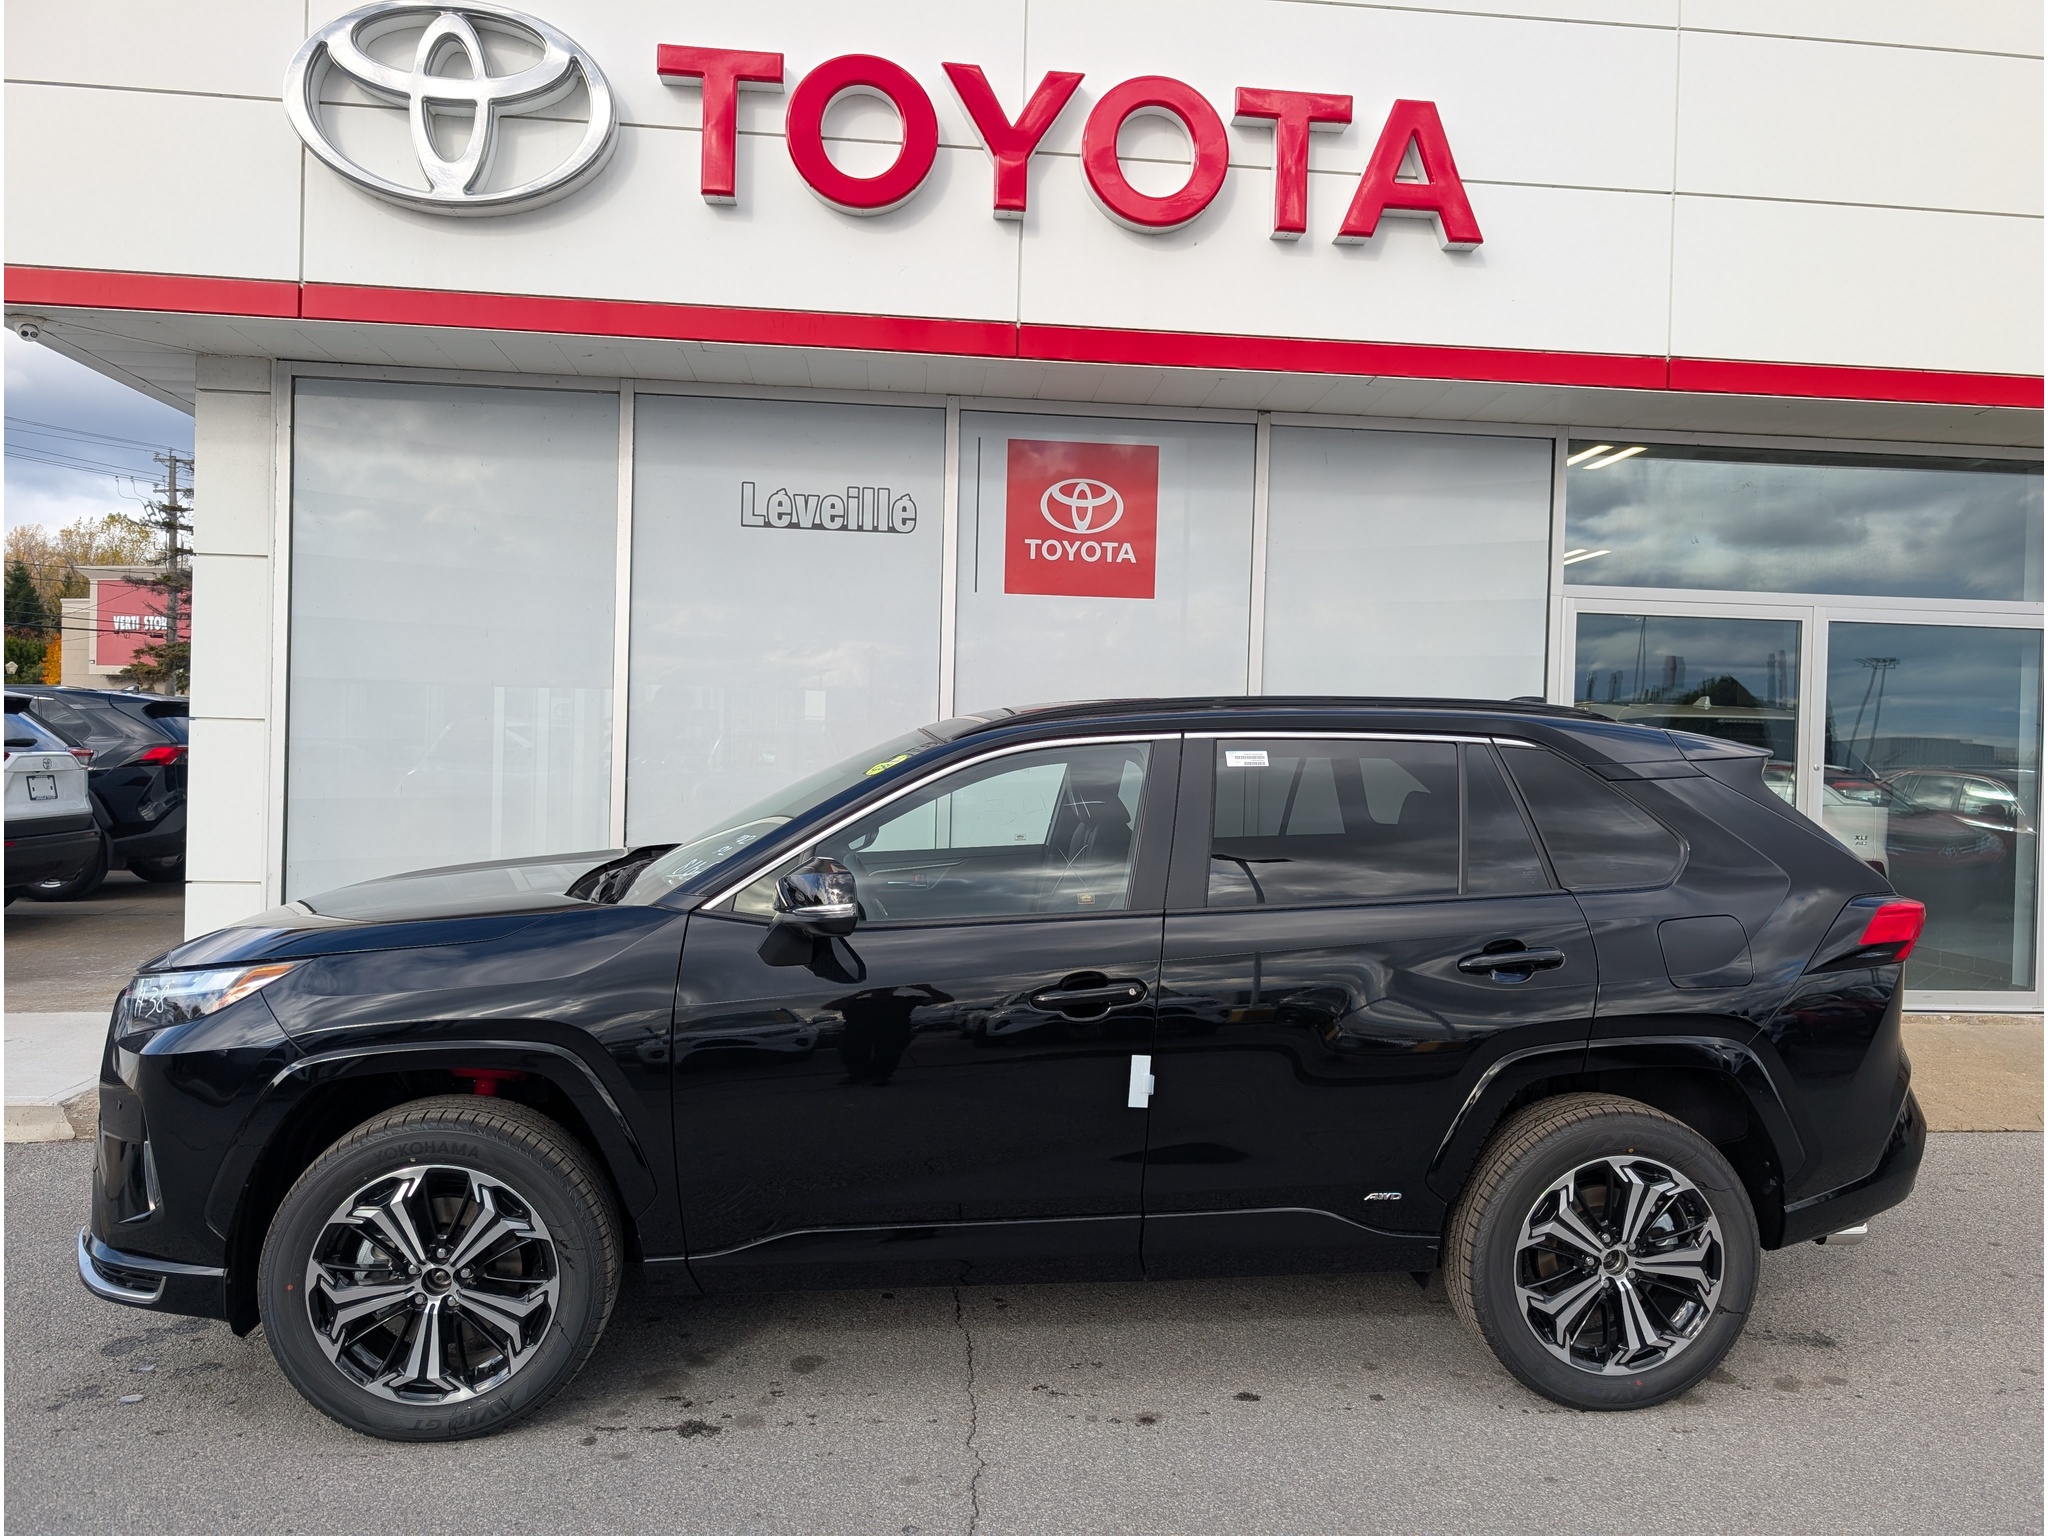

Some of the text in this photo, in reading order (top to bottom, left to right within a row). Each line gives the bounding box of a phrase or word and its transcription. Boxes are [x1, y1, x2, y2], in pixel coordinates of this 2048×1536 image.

[657, 43, 1484, 251] TOYOTA
[741, 481, 917, 534] Léveillé
[1024, 538, 1137, 563] TOYOTA
[113, 615, 168, 630] VERTI STOR
[373, 1141, 480, 1159] YOKOHAMA
[1364, 1192, 1402, 1201] AWD
